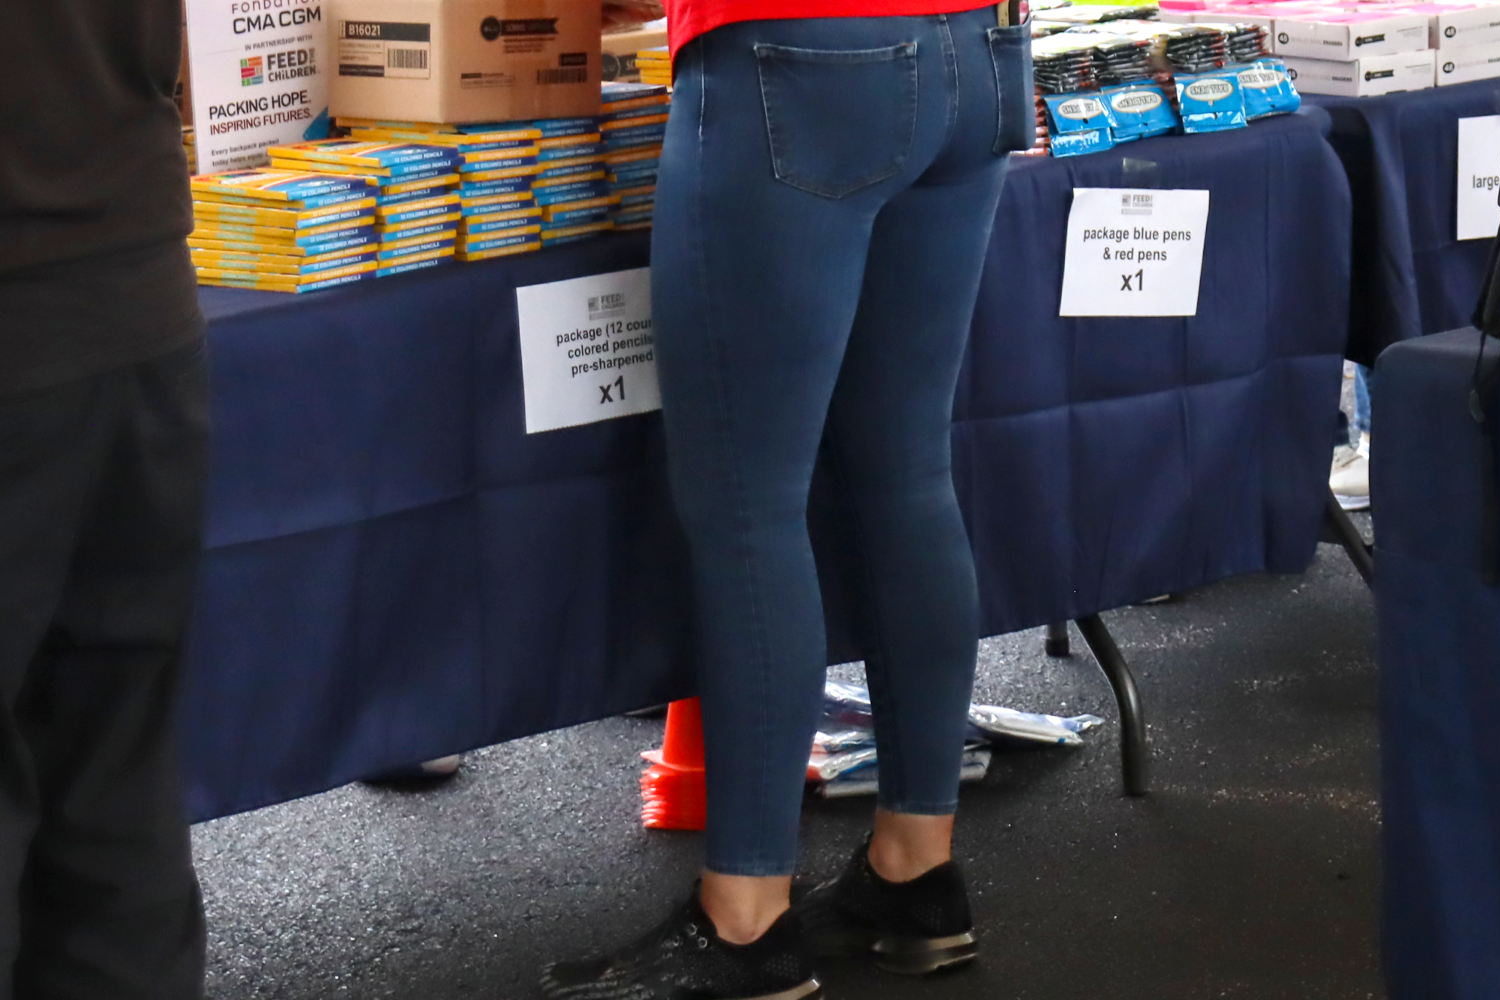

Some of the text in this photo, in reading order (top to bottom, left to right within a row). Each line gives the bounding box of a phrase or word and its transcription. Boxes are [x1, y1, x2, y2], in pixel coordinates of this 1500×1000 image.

[233, 6, 322, 35] CMA CGM
[348, 23, 381, 36] B16021
[244, 34, 313, 51] IN PARTNERSHIP WITH
[267, 50, 308, 70] FEED
[209, 97, 268, 120] PACKING
[209, 116, 261, 136] INSPIRING
[211, 138, 280, 157] Every backpack packed
[212, 158, 229, 168] today
[230, 155, 247, 164] helps
[1472, 175, 1500, 191] large
[1083, 226, 1192, 244] package blue pens
[1102, 246, 1168, 264] & red pens
[1120, 268, 1144, 292] x1
[556, 327, 602, 347] package
[605, 321, 623, 338] (12
[568, 333, 654, 359] colored pencils
[571, 349, 654, 378] pre-sharpened
[599, 375, 626, 405] x1
